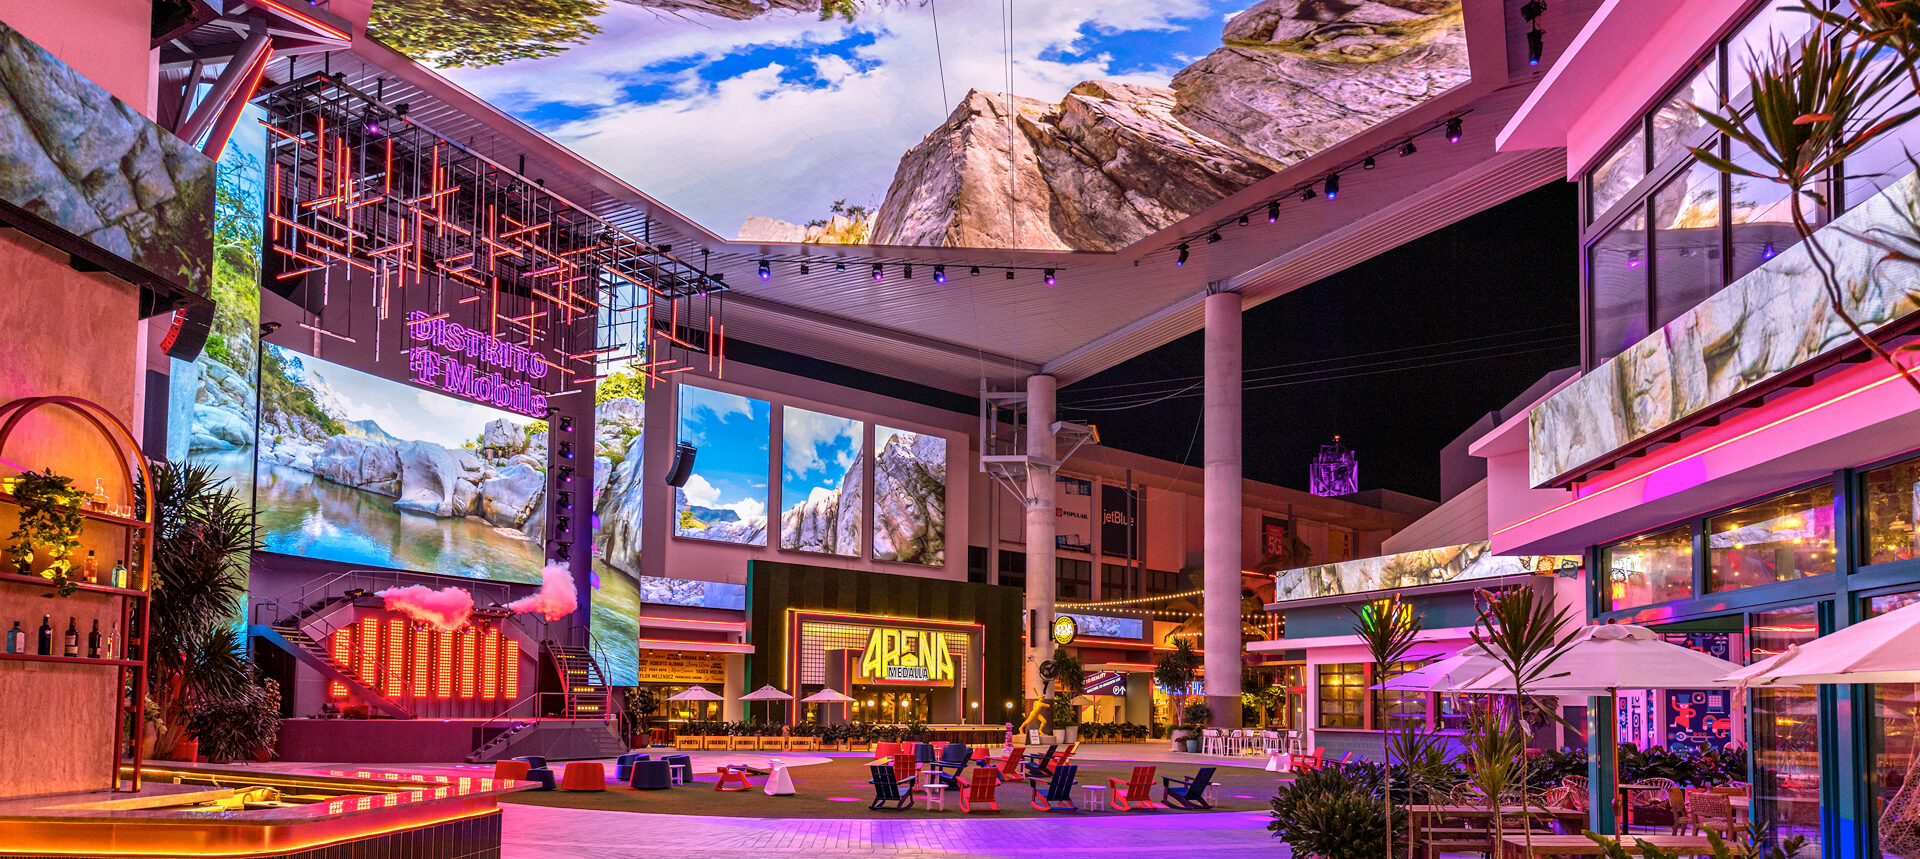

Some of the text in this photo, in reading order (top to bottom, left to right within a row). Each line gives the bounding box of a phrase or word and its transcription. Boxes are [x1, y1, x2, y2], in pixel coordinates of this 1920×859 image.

[410, 310, 548, 379] DISTRITO
[442, 357, 548, 418] Mobile
[1063, 510, 1088, 519] POPULAR
[862, 628, 954, 680] ARENA
[888, 667, 929, 679] MEDALLA
